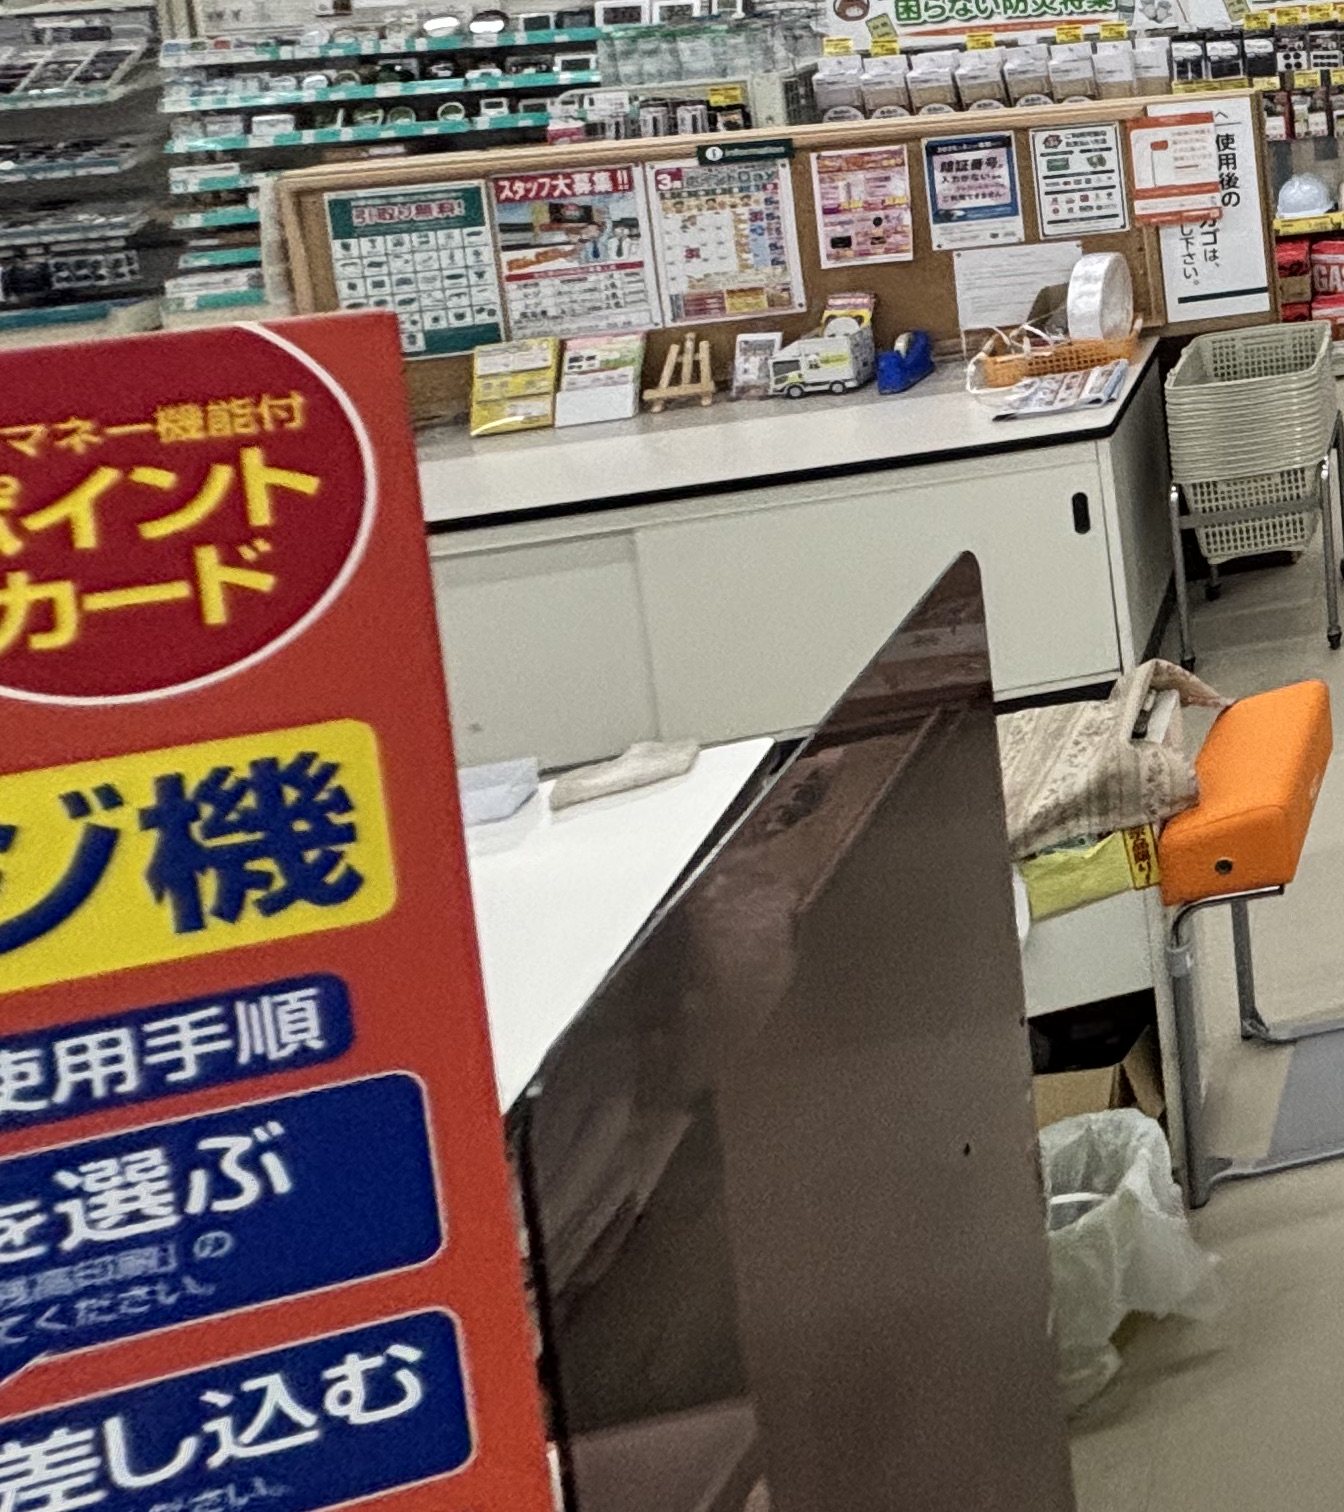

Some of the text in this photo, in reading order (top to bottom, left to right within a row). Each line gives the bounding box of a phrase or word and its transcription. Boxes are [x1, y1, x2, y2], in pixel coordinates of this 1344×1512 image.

[1215, 133, 1241, 208] 使用後の
[3, 391, 307, 458] マネー機能付
[0, 539, 278, 655] カード
[0, 1344, 425, 1512] 差し込む
